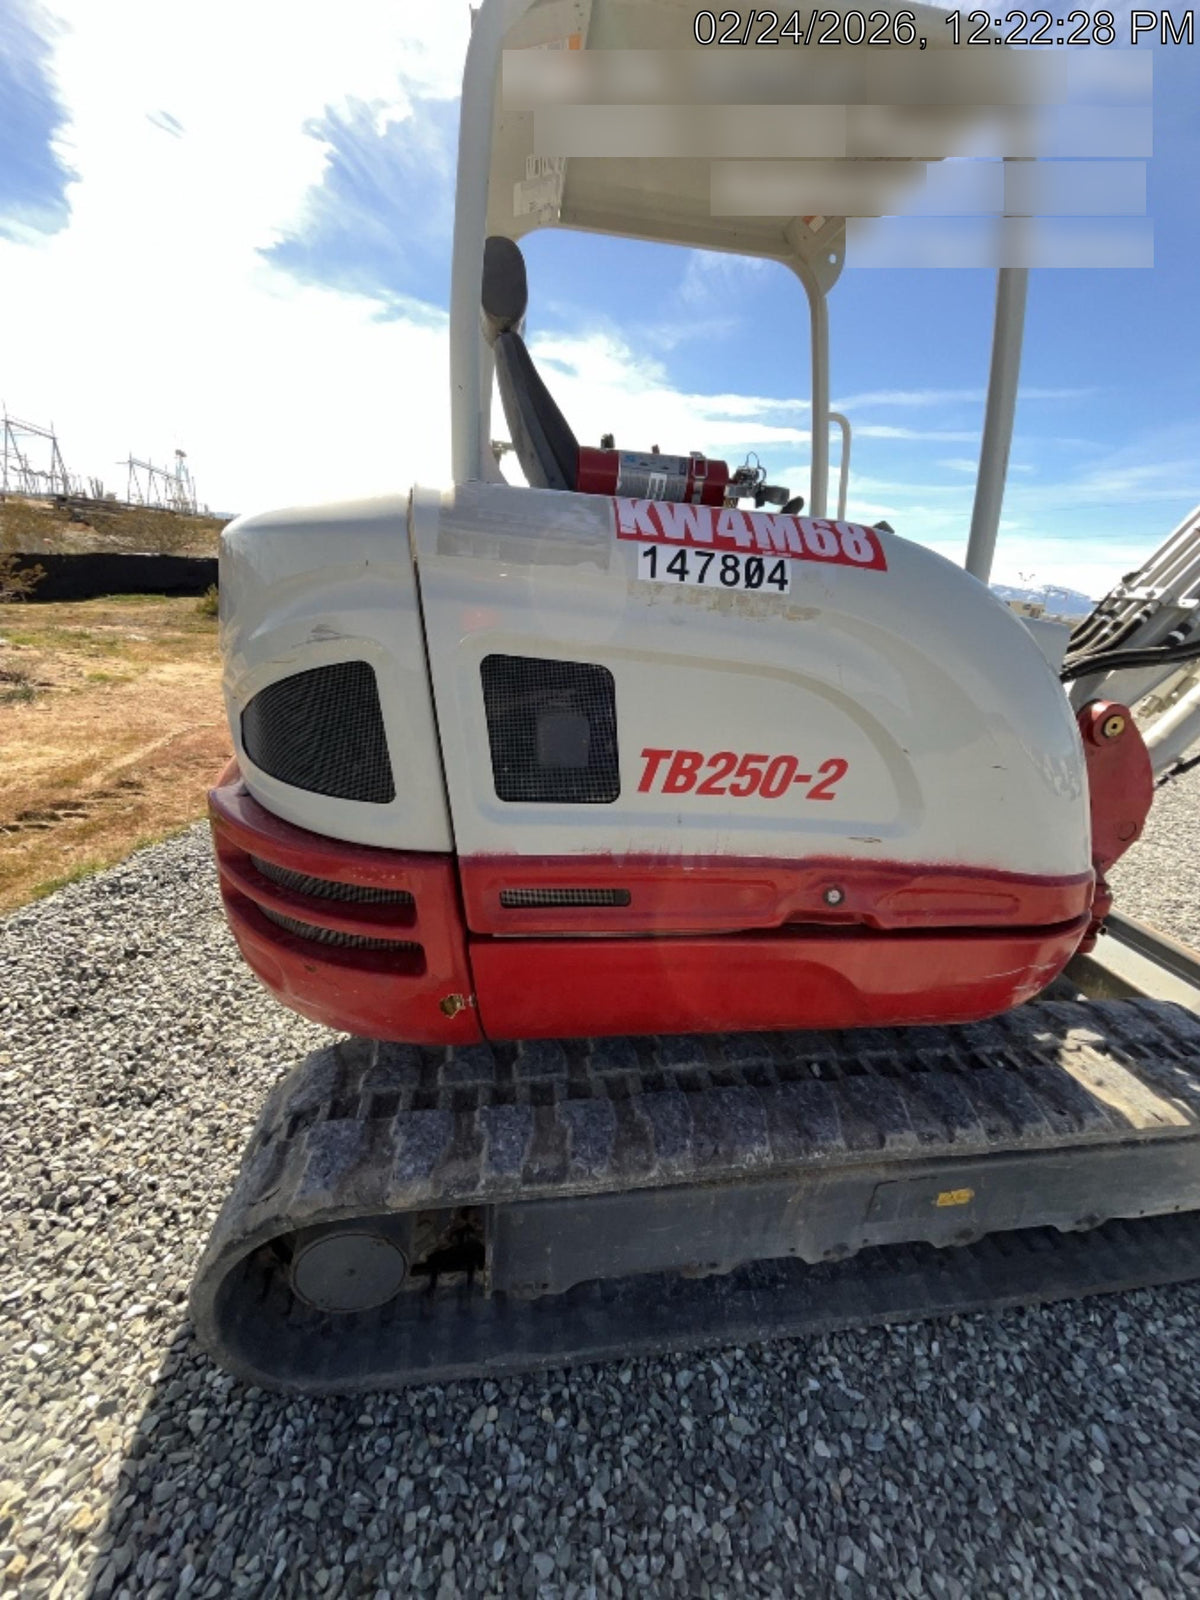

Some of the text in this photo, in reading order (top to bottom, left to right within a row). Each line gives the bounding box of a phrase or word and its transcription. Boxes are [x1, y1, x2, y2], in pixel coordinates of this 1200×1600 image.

[617, 500, 875, 563] KW4M68
[642, 545, 789, 591] 147804
[637, 748, 849, 800] TB250-2
